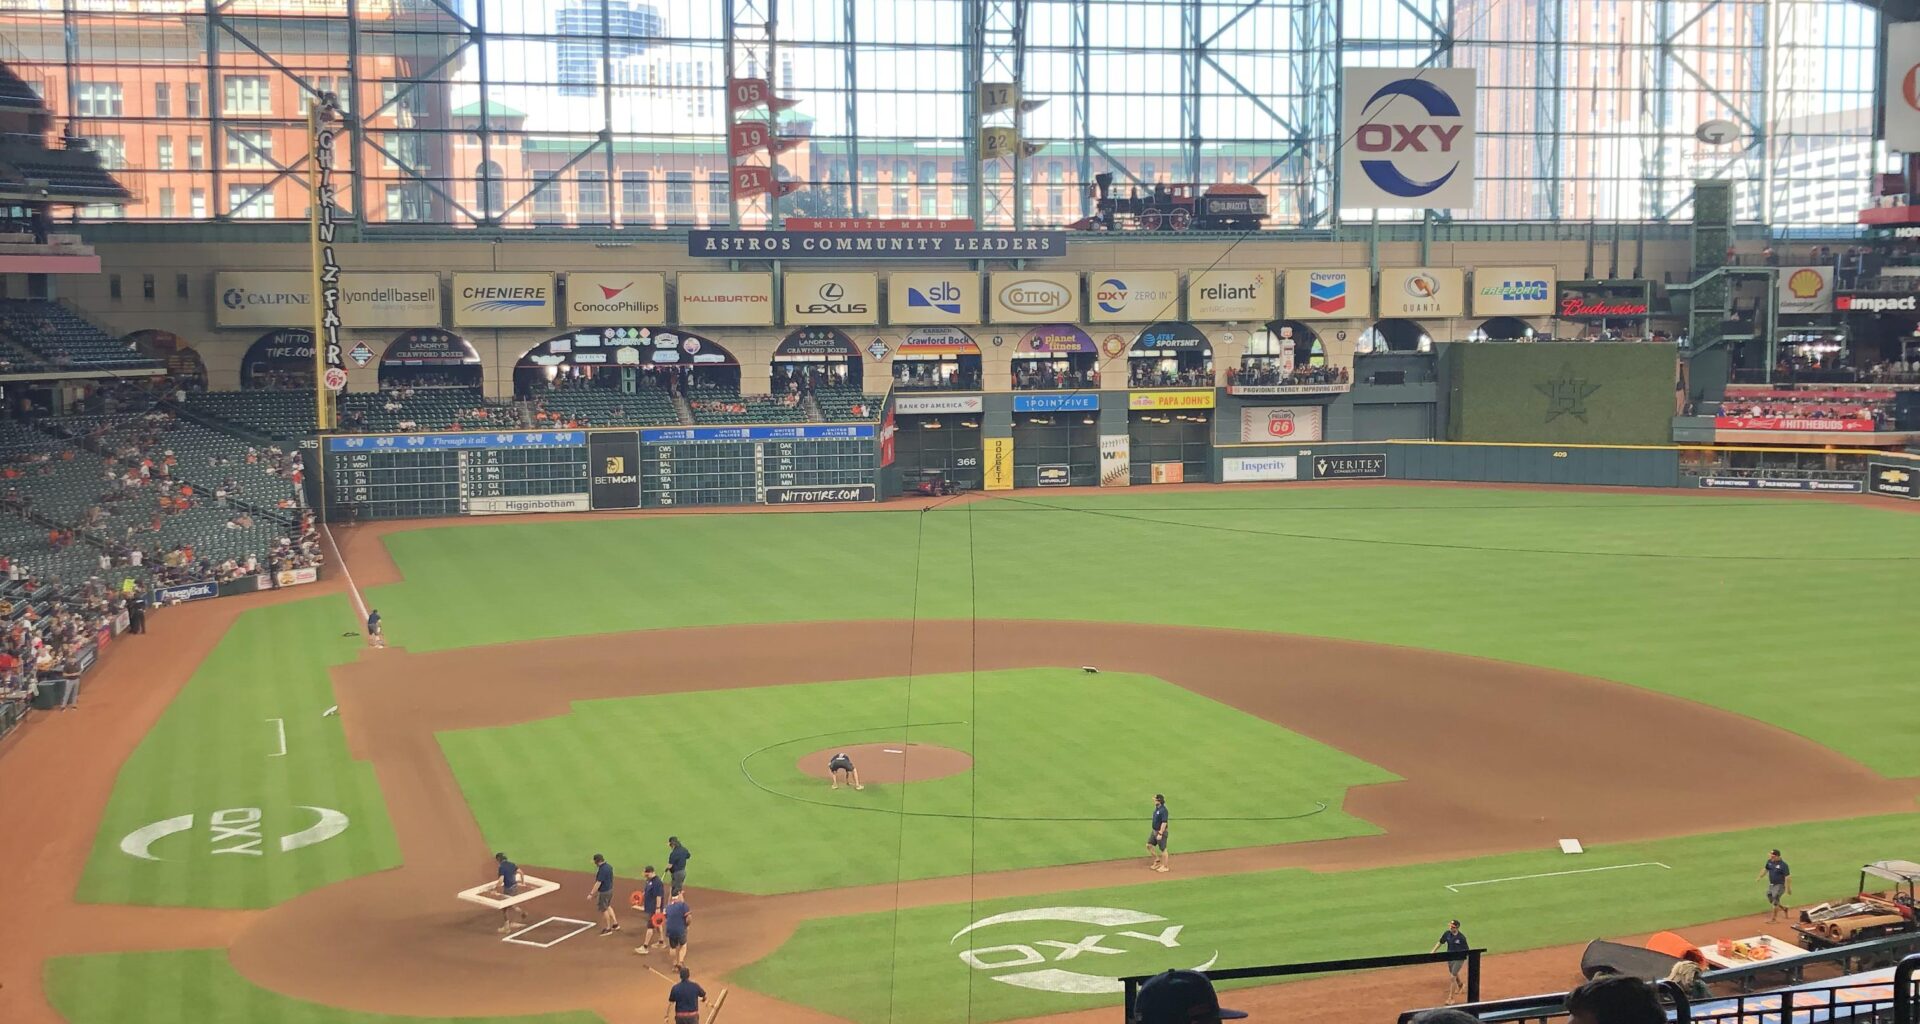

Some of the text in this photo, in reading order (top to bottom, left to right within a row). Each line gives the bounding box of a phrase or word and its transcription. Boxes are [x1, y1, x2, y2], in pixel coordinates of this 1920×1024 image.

[738, 85, 759, 102] 05
[989, 89, 1008, 105] 17
[741, 130, 761, 146] 19
[988, 134, 1008, 149] 22
[1357, 124, 1463, 152] OXY
[740, 172, 760, 188] 21
[813, 220, 949, 229] MINUTE MAID
[705, 237, 1052, 251] ASTROS COMMUNITY LEADERS
[1310, 272, 1347, 281] Chevron
[342, 288, 435, 304] lyondellbasell
[463, 287, 546, 299] CHENIERE
[929, 281, 960, 301] slb
[1097, 292, 1128, 300] OXY
[1134, 291, 1157, 300] ZERO
[1200, 283, 1256, 299] reliant
[1481, 287, 1540, 296] FREEPORT
[1503, 281, 1548, 300] LNG
[247, 294, 311, 304] CALPINE
[683, 295, 768, 303] HALLIBURTON
[1008, 288, 1060, 307] COTTON
[574, 301, 659, 313] ConocoPhillips
[796, 303, 867, 314] LEXUS
[1403, 304, 1441, 312] QUANTA
[1562, 298, 1648, 315] Budweiser
[1850, 296, 1916, 312] impact
[323, 288, 341, 364] FAIR
[275, 334, 310, 344] NITTO
[907, 336, 969, 345] Crawford Bock
[1045, 334, 1076, 344] planet
[1156, 339, 1199, 347] SPORTSNET
[1049, 342, 1081, 351] fitness
[1025, 399, 1089, 407] 1POINTFIVE
[1158, 396, 1178, 406] PAPA
[1180, 396, 1210, 405] JOHN'S
[1272, 422, 1289, 432] 66
[1780, 419, 1843, 430] #HITTHEBUDS
[433, 437, 466, 446] Through
[1103, 451, 1127, 460] WM
[957, 458, 976, 466] 366
[1241, 460, 1286, 472] Insperity
[1331, 459, 1382, 470] VERITEX
[595, 476, 636, 484] BETMGM
[1880, 484, 1910, 492] CHEVROLET
[781, 489, 860, 501] NITTOTIRE.COM
[505, 500, 575, 510] Higginbotham
[162, 585, 211, 600] AmegyBank
[211, 807, 263, 855] OXY
[959, 925, 1184, 969] OXY
